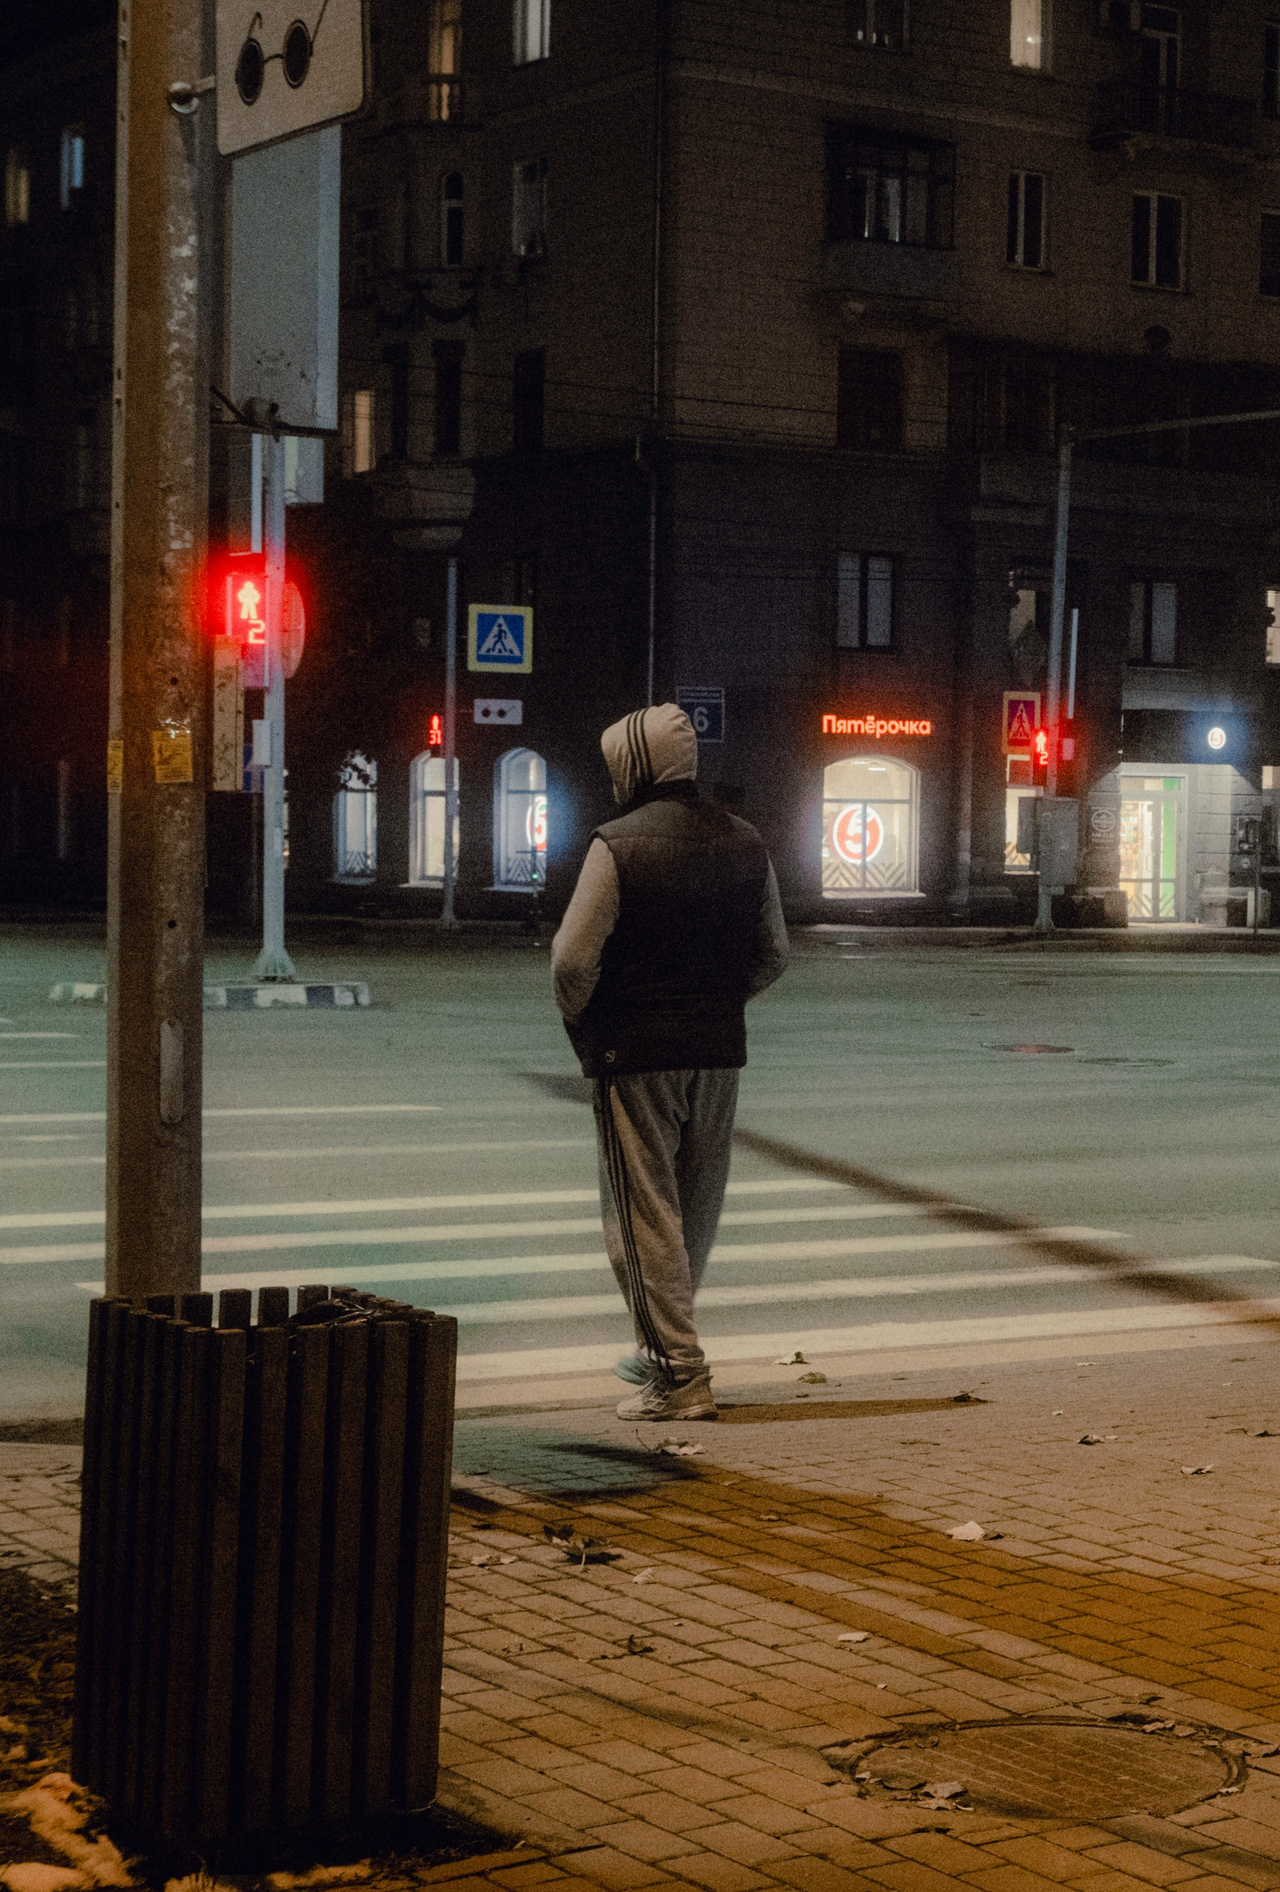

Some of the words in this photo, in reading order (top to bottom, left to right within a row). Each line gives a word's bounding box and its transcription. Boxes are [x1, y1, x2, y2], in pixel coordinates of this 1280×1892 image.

[248, 619, 266, 644] 2
[693, 706, 709, 732] 6
[822, 714, 932, 739] Пятёрочка
[1040, 751, 1049, 765] 2
